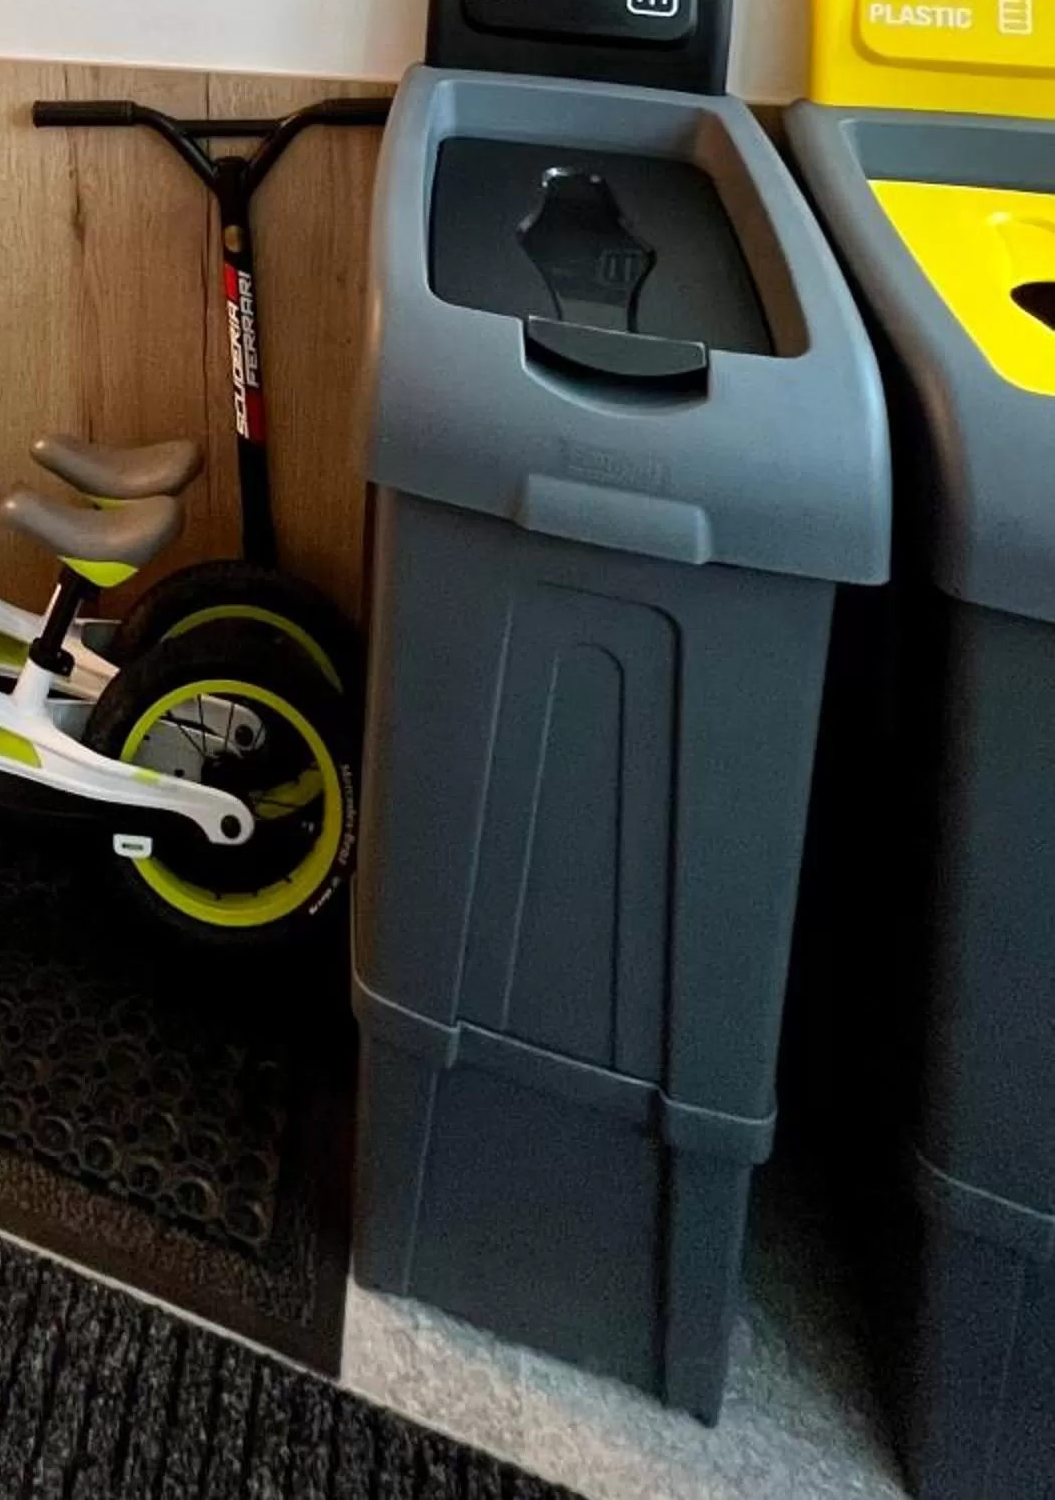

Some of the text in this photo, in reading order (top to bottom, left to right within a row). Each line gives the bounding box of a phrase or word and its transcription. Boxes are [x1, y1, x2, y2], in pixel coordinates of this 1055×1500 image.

[869, 3, 972, 29] PLASTIC
[226, 300, 250, 439] SCUDERIA
[238, 270, 259, 388] FERRARI
